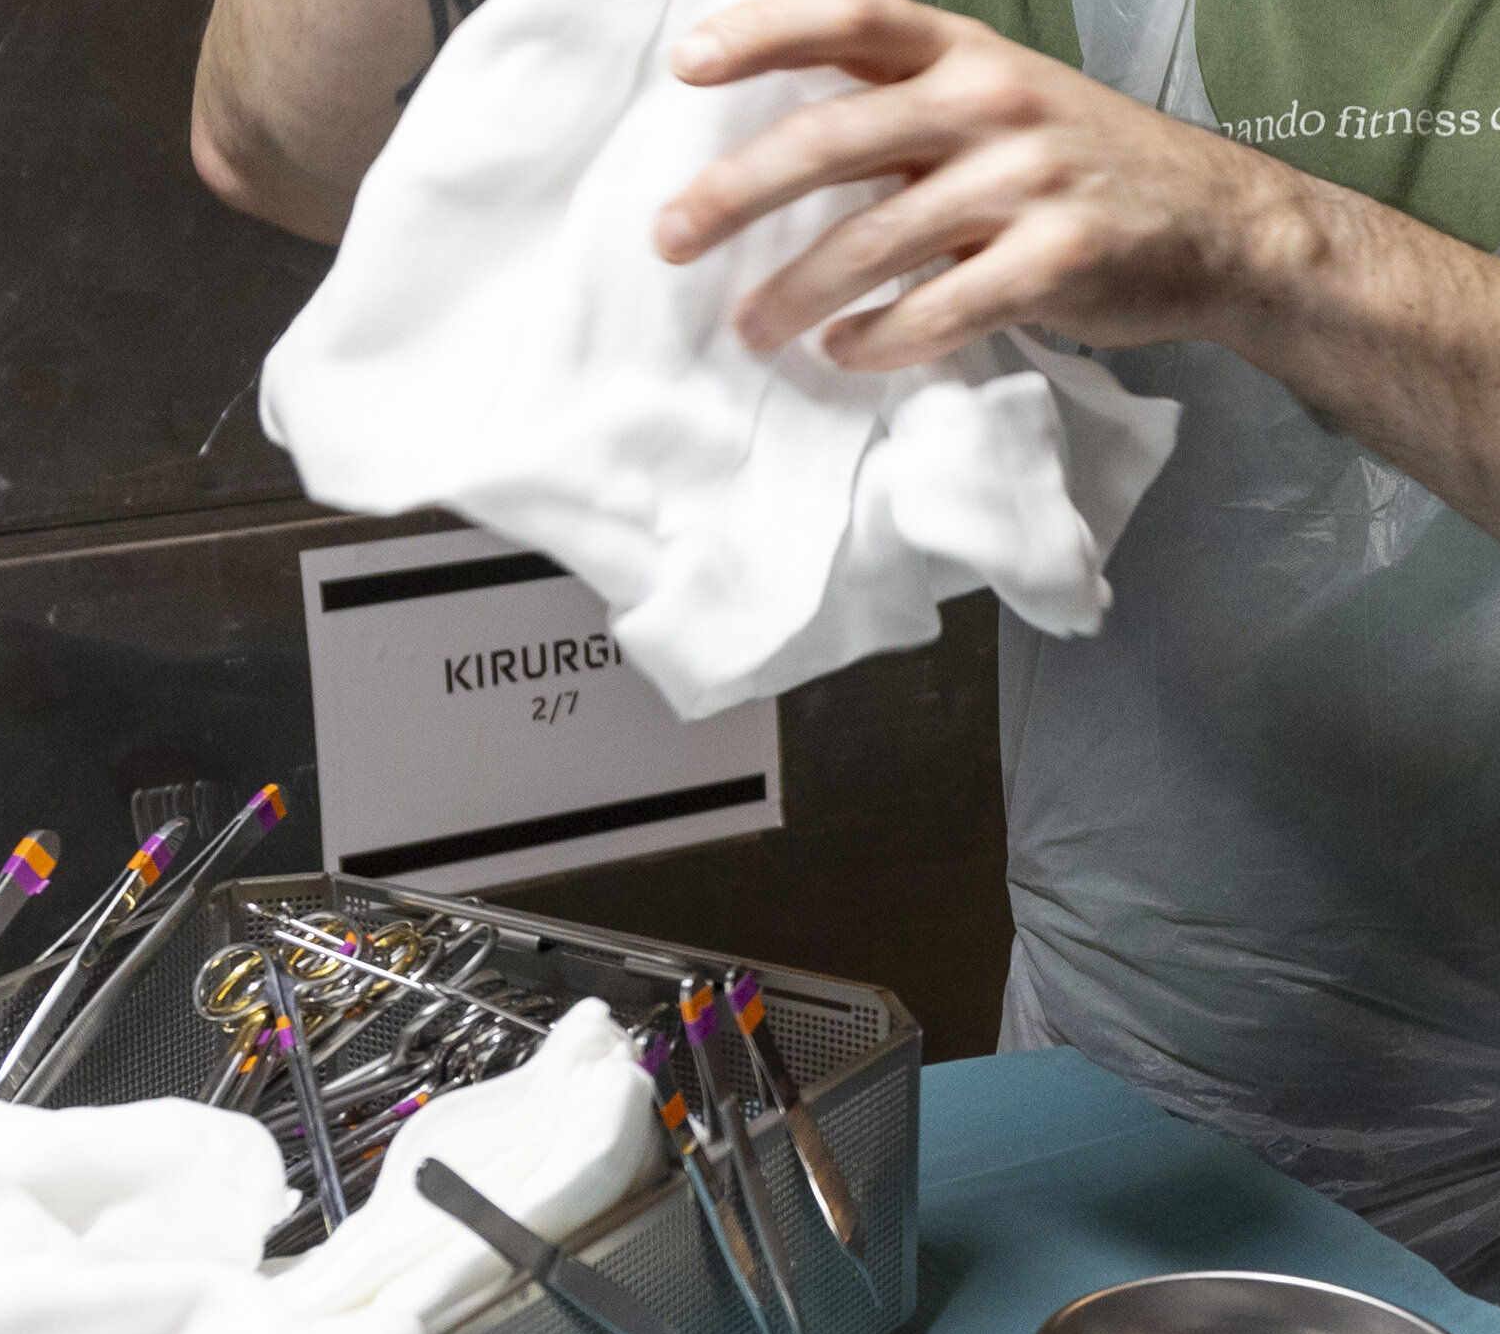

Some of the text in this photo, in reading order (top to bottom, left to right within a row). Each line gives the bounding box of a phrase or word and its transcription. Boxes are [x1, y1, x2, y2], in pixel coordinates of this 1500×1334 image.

[1335, 105, 1481, 140] fitness
[444, 632, 622, 695] KIRURGI
[531, 690, 580, 725] 2/7
